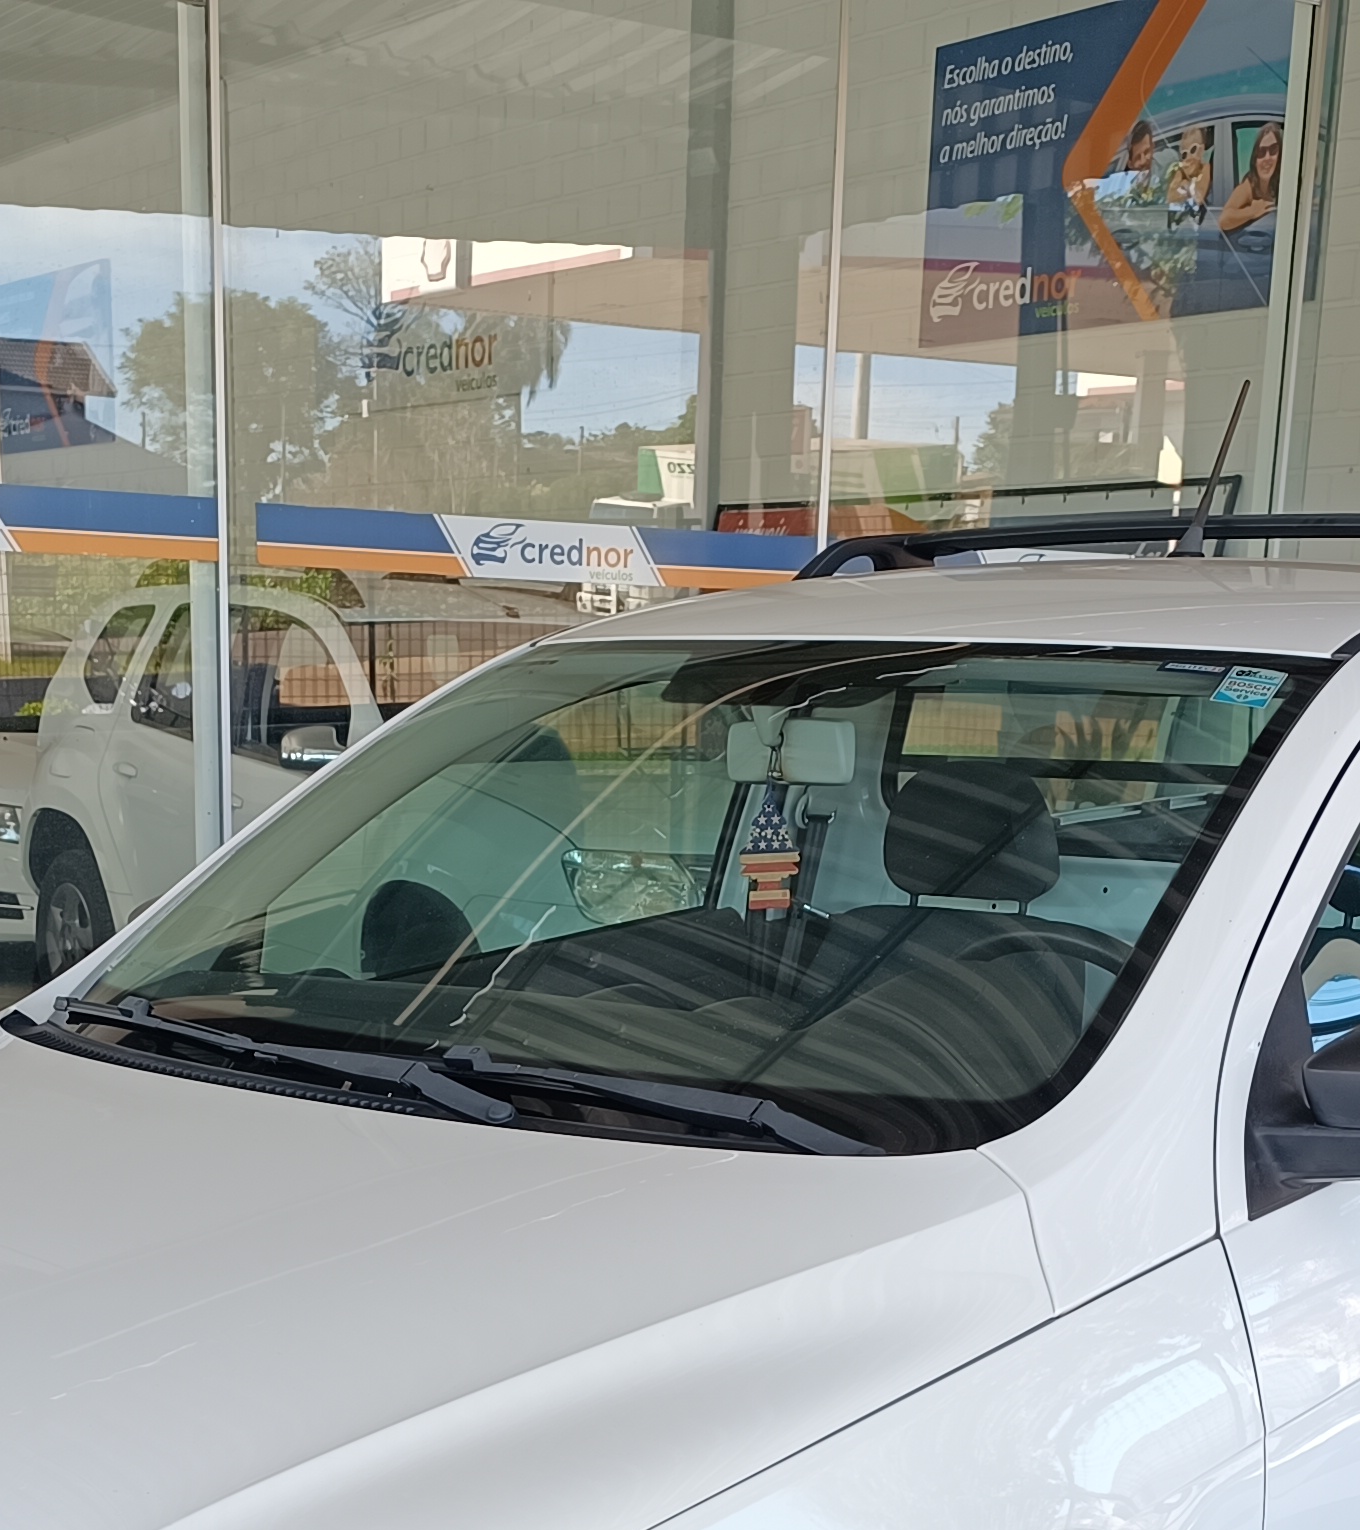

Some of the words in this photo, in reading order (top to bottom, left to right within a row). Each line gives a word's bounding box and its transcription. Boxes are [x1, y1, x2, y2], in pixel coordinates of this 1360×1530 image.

[943, 56, 999, 89] Escolha
[1001, 56, 1012, 75] o
[1015, 40, 1074, 72] destino,
[941, 101, 968, 127] nós
[970, 84, 1056, 127] garantimos
[939, 145, 951, 164] a
[952, 131, 1006, 161] melhor
[1006, 114, 1069, 150] direção!
[972, 266, 1082, 311] crednor
[402, 333, 497, 377] crednor
[520, 538, 635, 569] crednor
[589, 570, 633, 581] veículos
[1224, 686, 1268, 697] Service
[1228, 681, 1272, 692] BOSCH
